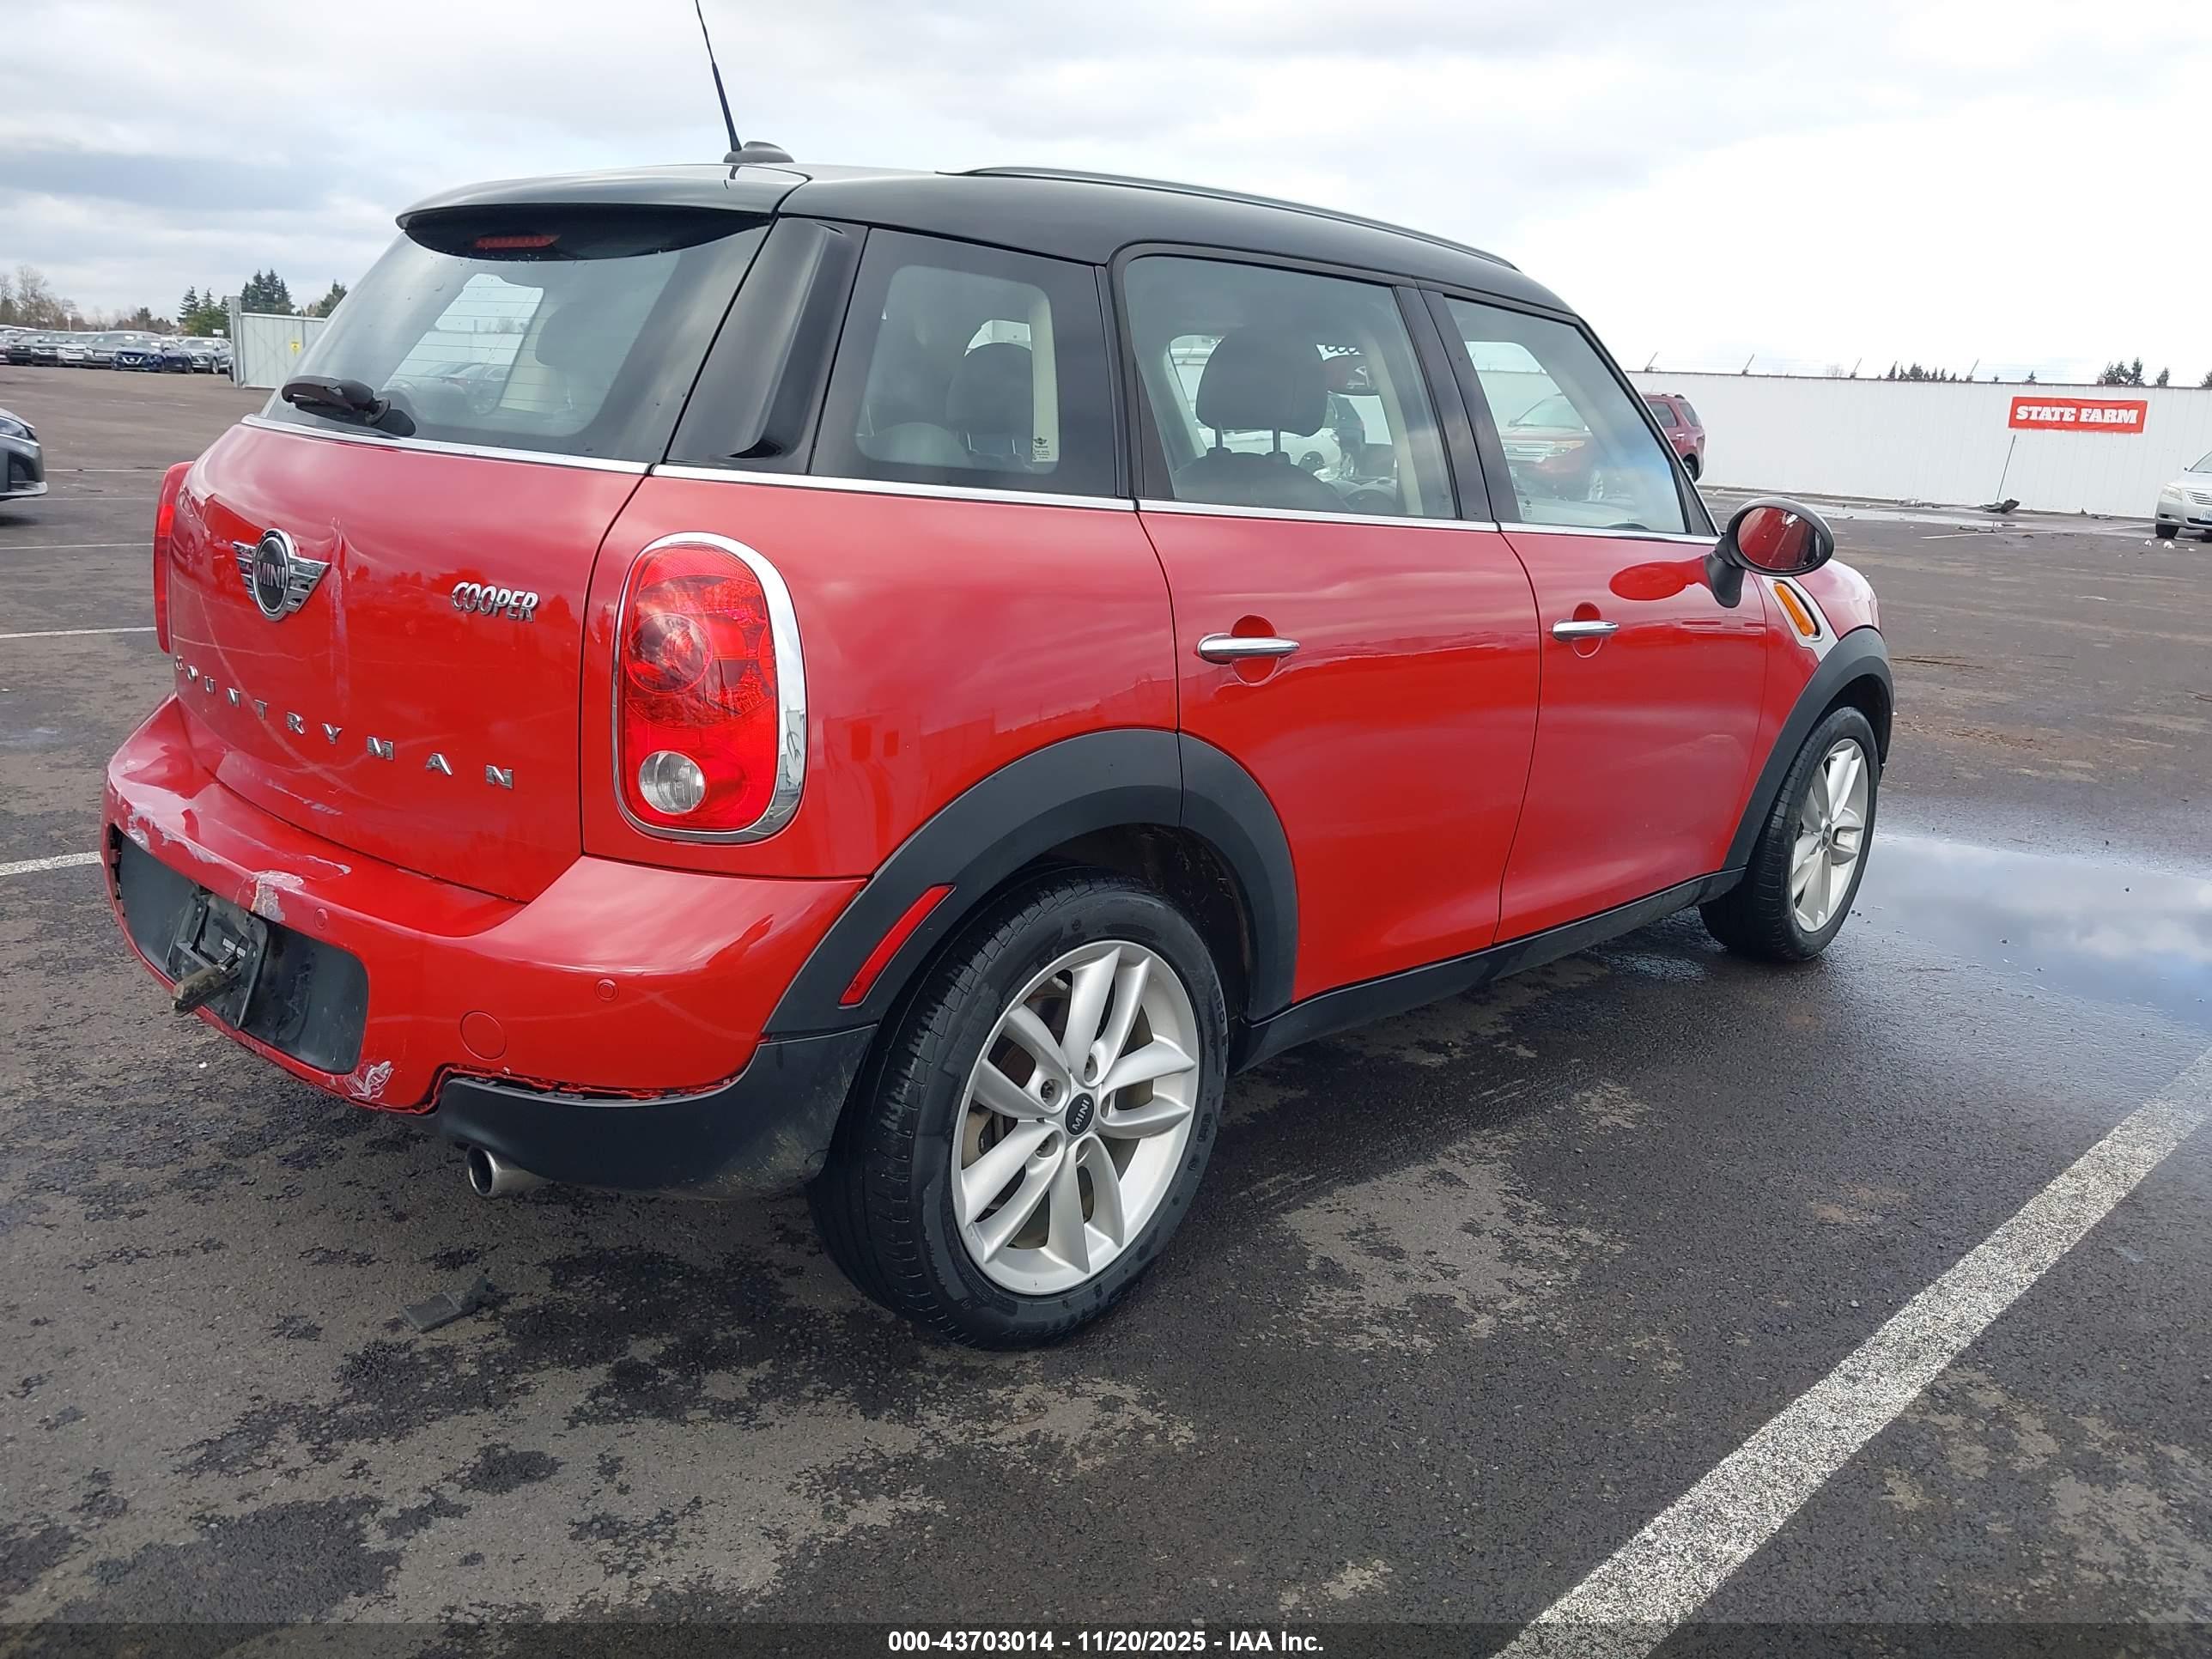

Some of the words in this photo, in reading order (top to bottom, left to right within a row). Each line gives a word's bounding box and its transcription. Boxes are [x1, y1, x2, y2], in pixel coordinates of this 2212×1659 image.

[2015, 405, 2077, 422] STATE
[2079, 408, 2139, 424] FARM
[257, 560, 286, 589] MINI
[451, 581, 539, 623] COOPER
[174, 654, 514, 790] COUNTRYMAN
[1071, 1098, 1091, 1131] MINI
